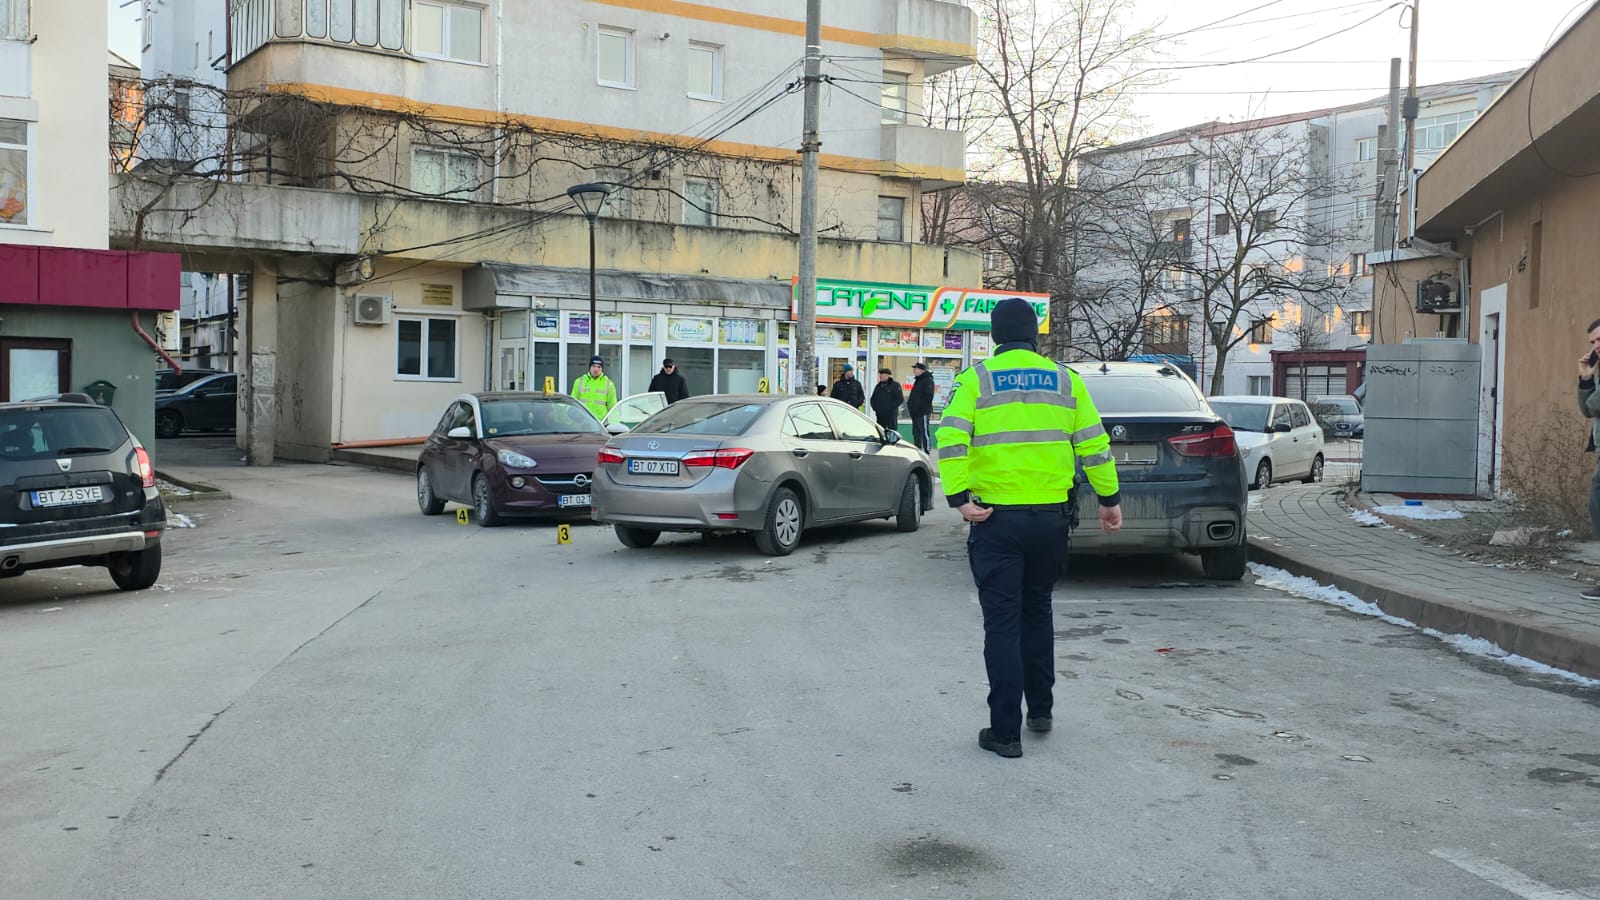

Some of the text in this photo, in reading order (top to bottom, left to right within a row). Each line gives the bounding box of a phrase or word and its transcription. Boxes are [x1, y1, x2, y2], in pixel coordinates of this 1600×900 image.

[815, 285, 929, 312] CATENA
[997, 373, 1054, 387] POLITIA
[758, 381, 766, 393] 2
[633, 461, 677, 472] BT 07 XTD
[39, 492, 56, 503] BT
[562, 496, 573, 505] BT
[576, 495, 586, 504] 02
[459, 510, 466, 522] 4
[561, 527, 569, 541] 3
